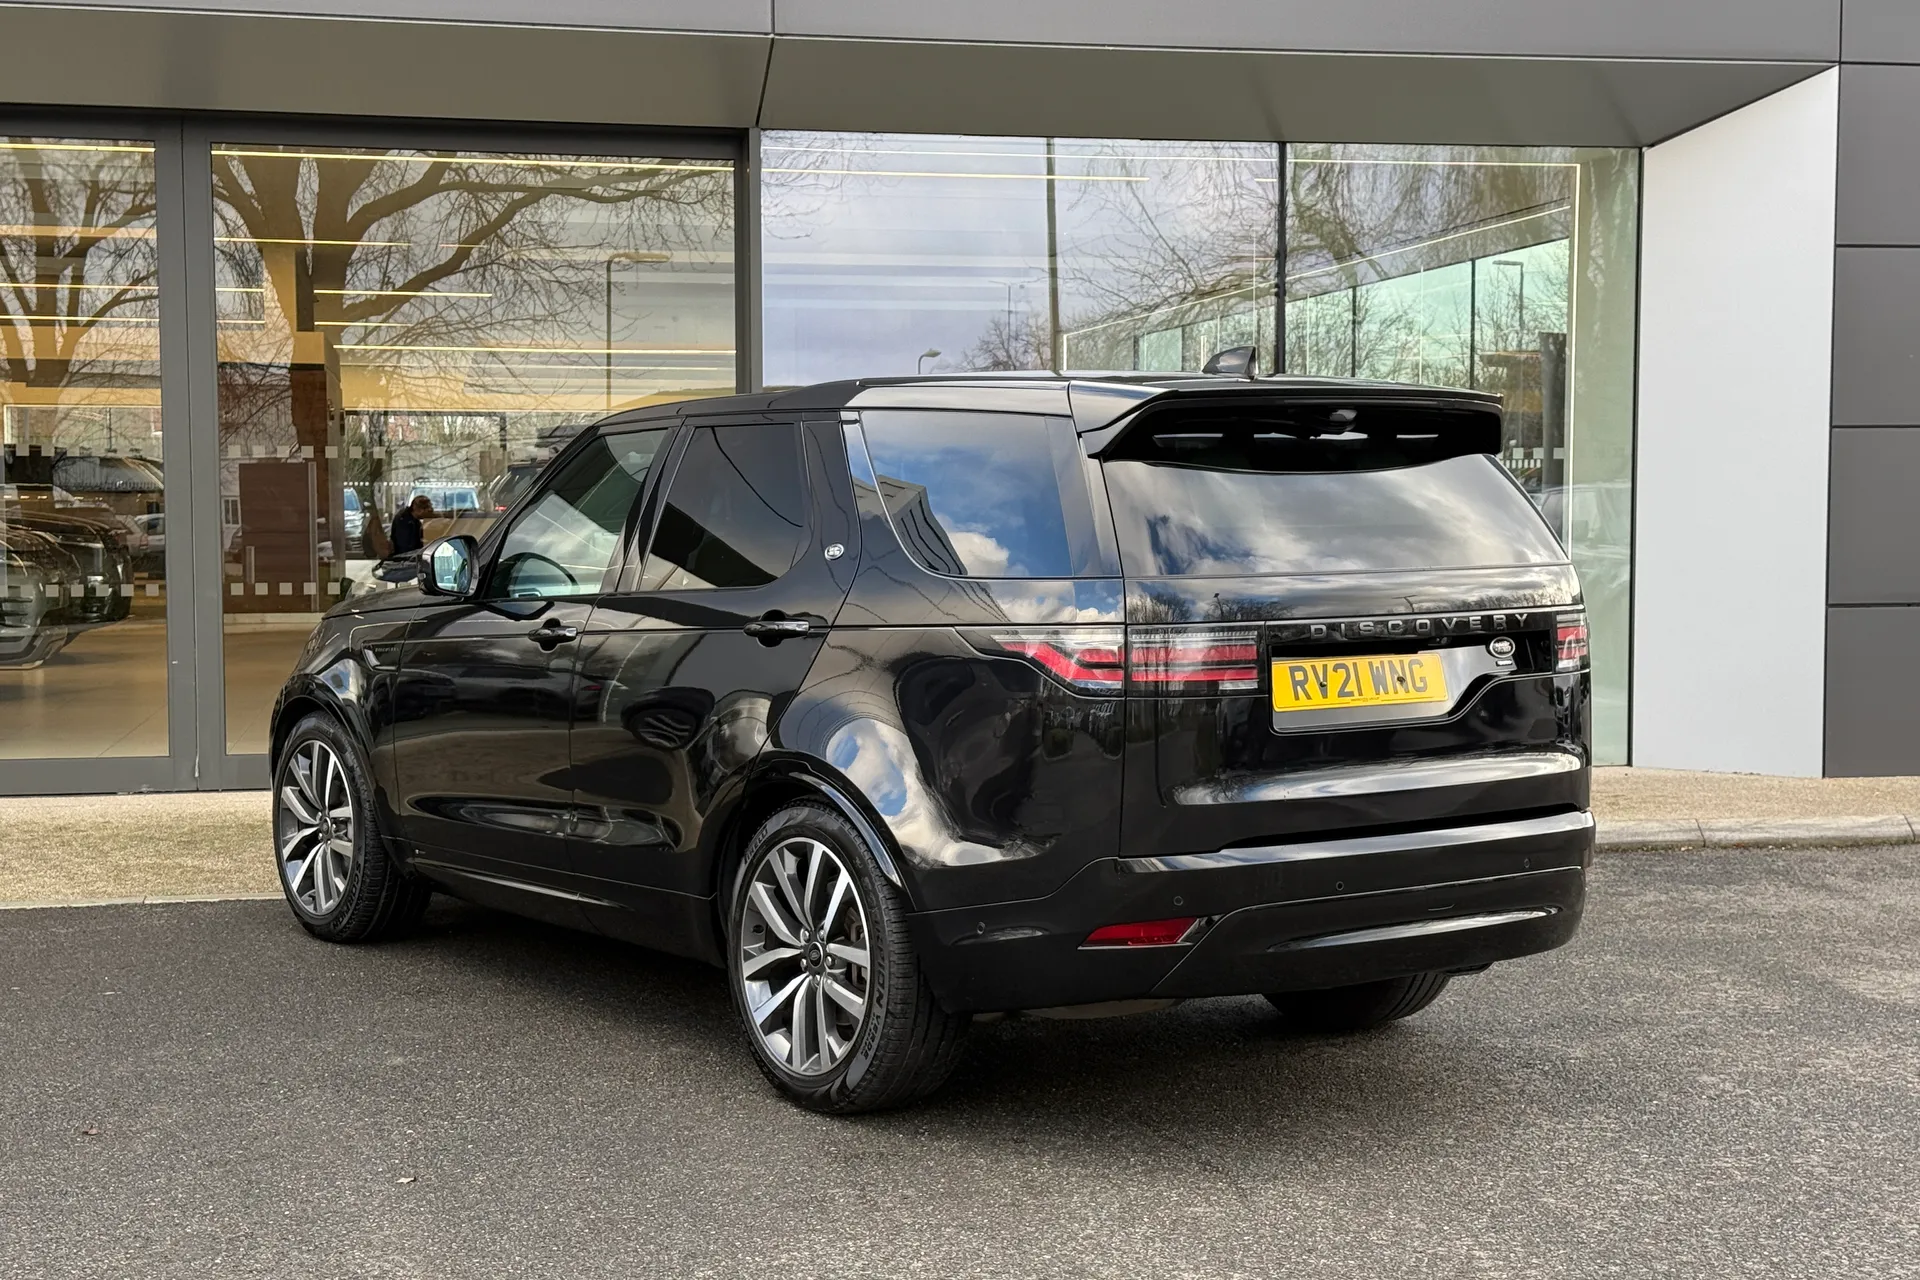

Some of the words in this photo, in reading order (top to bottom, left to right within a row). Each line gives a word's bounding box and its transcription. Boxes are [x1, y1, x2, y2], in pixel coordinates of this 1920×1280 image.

[1310, 613, 1529, 639] DISCOVERY
[1288, 661, 1364, 701] RV21
[1367, 658, 1428, 696] WNG
[862, 1013, 882, 1061] VERDE
